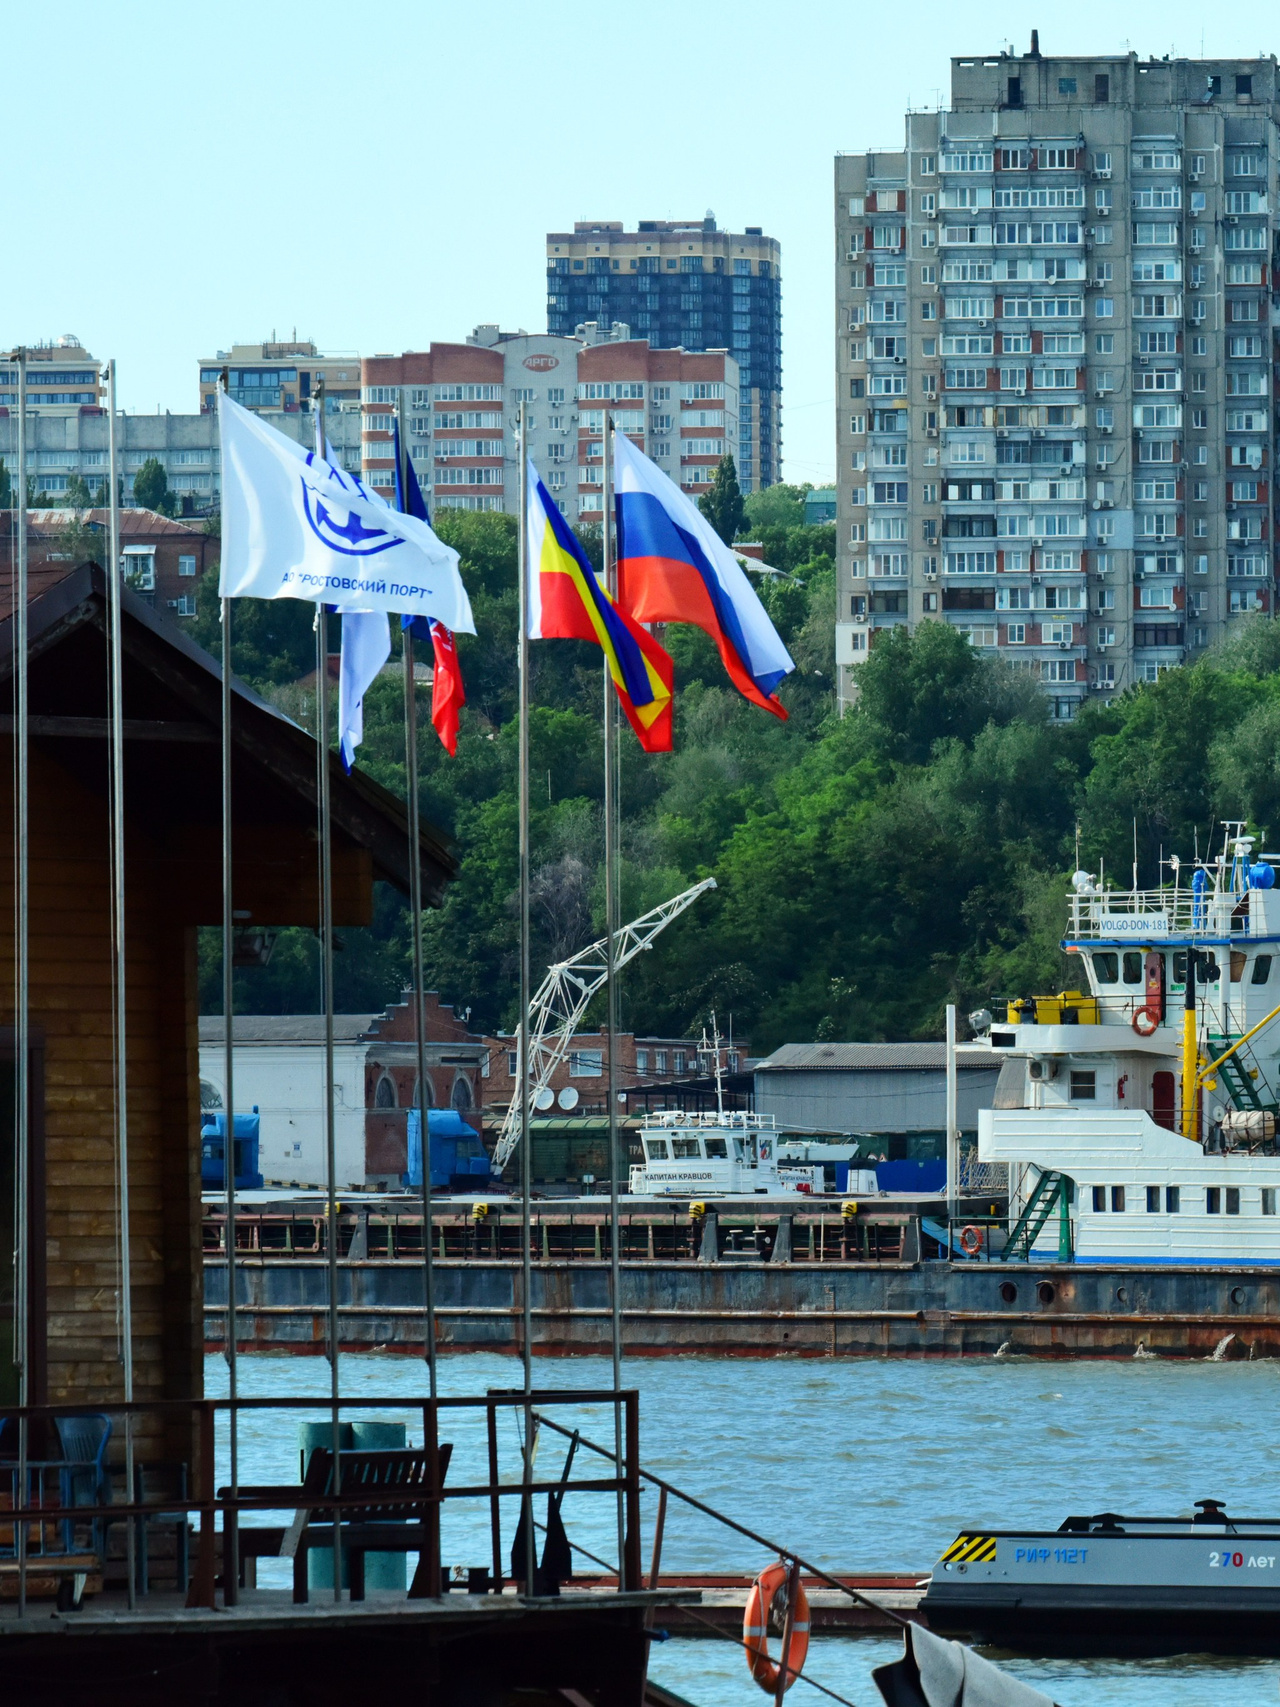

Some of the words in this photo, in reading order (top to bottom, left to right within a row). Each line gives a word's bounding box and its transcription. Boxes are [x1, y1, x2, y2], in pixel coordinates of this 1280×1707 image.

[525, 357, 556, 367] АРГО
[281, 572, 295, 583] АО
[298, 573, 386, 594] "РОСТОВСКИЙ
[389, 583, 433, 599] ПОРТ"
[1100, 920, 1167, 930] VOLGO-DON-181
[645, 1173, 677, 1181] КАПИТАН
[678, 1172, 713, 1181] КРАВЦОВ
[1015, 1548, 1051, 1563] РИФ
[1209, 1552, 1244, 1567] 270
[1247, 1556, 1276, 1568] лет
